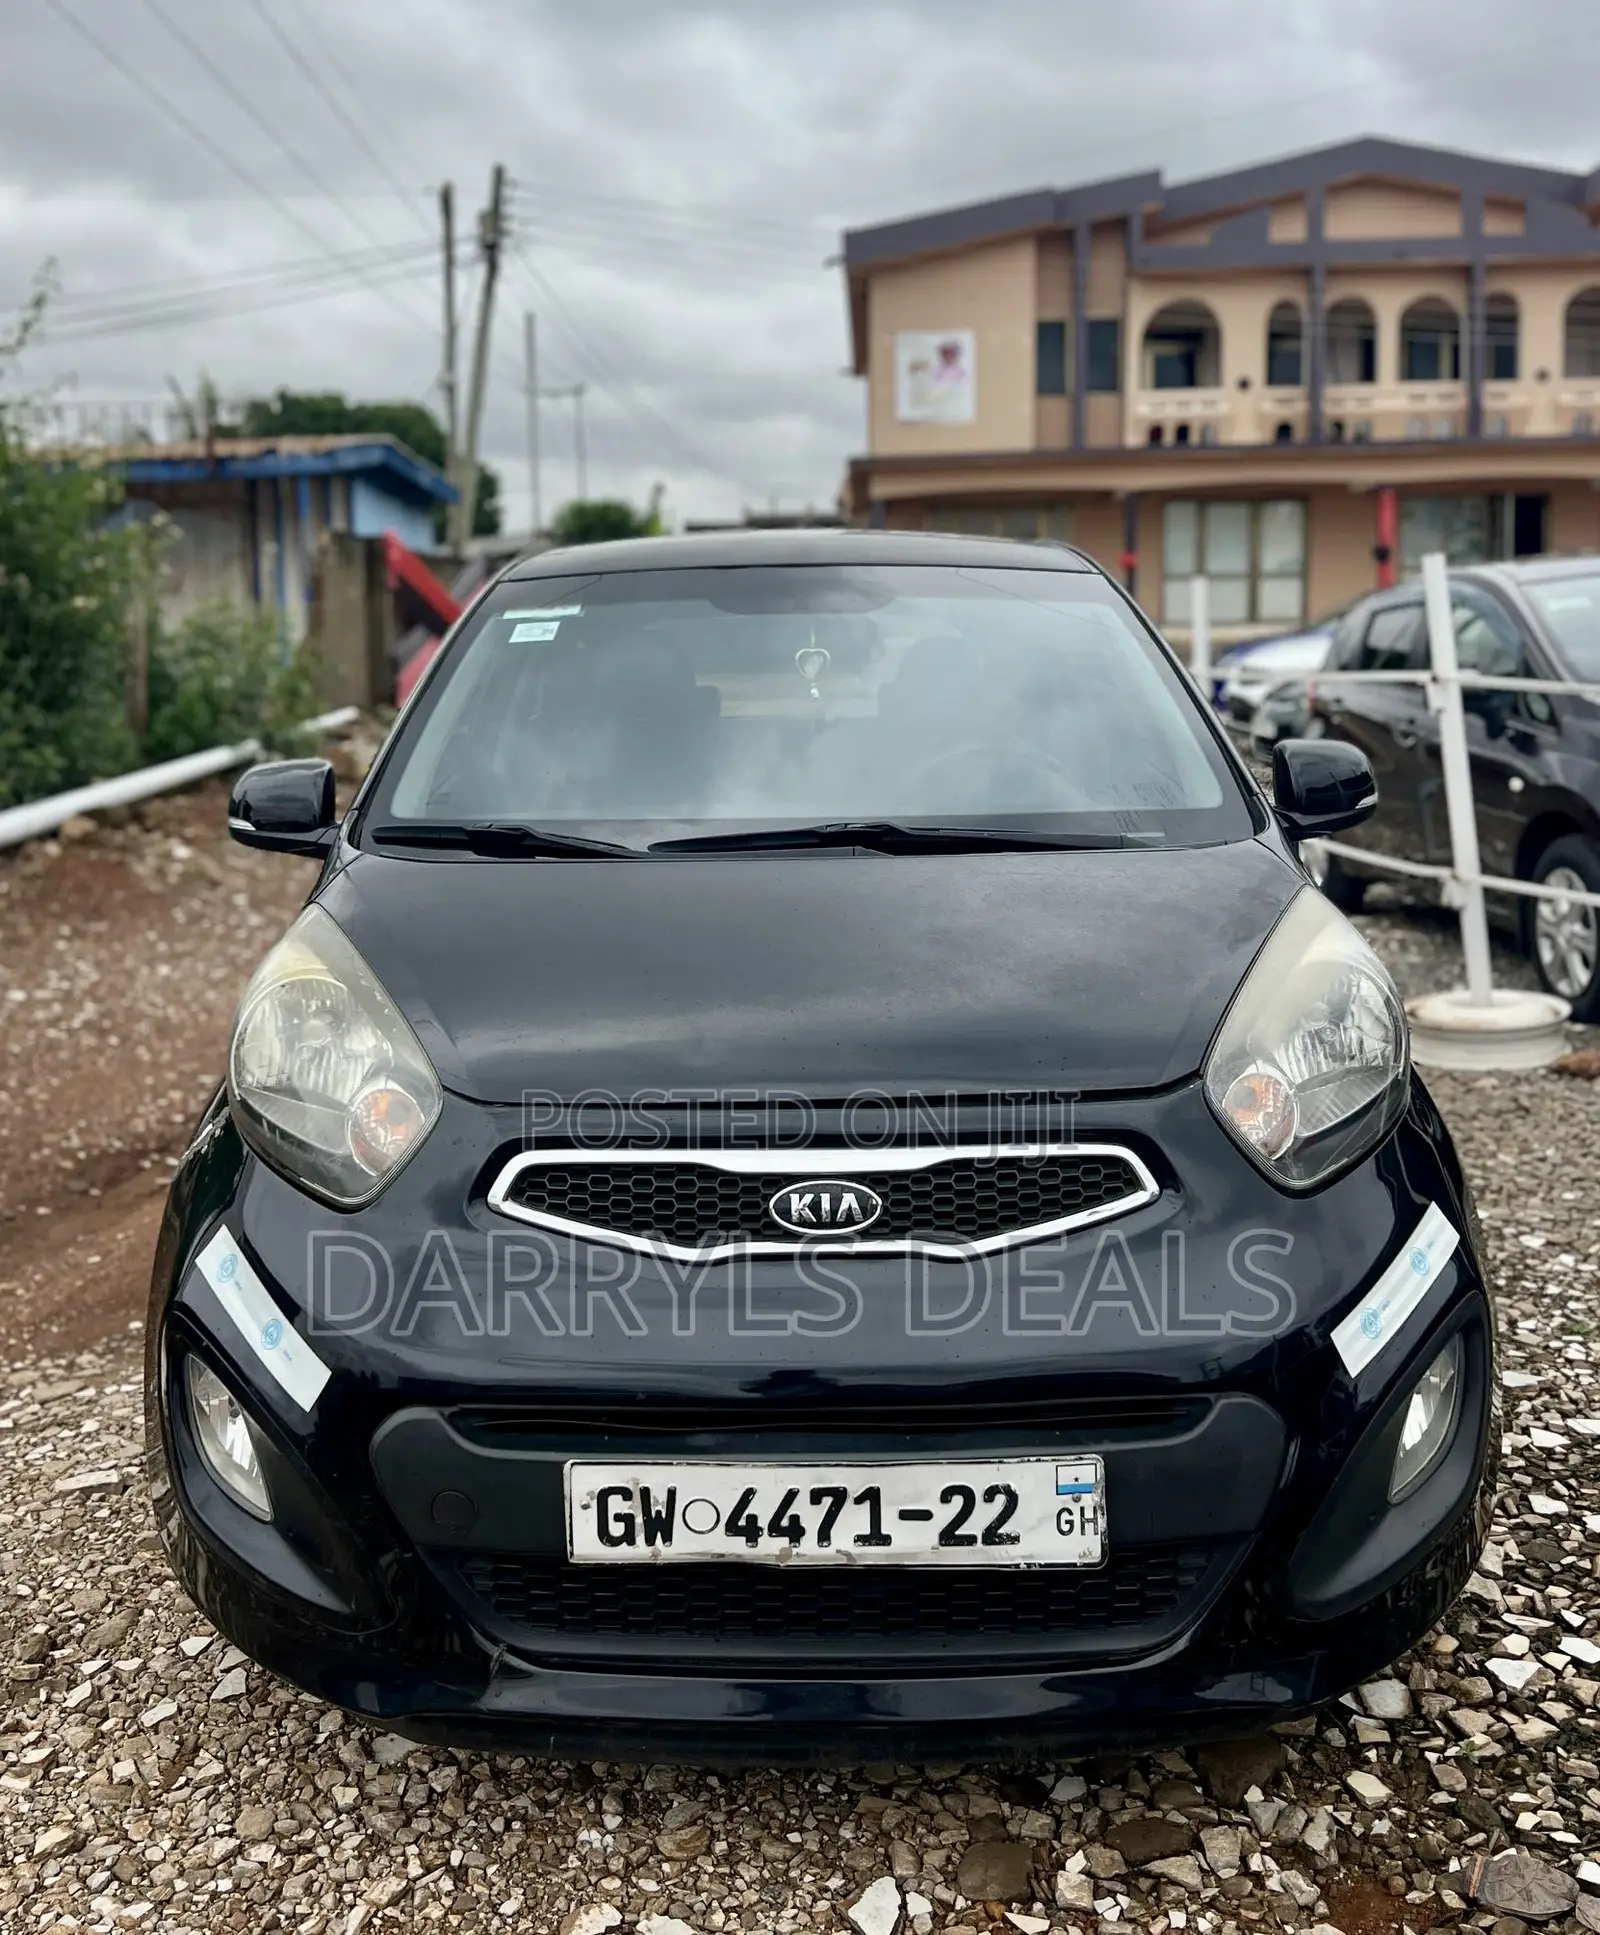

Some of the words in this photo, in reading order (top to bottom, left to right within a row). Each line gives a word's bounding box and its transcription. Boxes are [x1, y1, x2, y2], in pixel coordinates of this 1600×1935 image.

[789, 1192, 865, 1223] KIA
[596, 1485, 677, 1548] GW
[1056, 1506, 1099, 1537] GH
